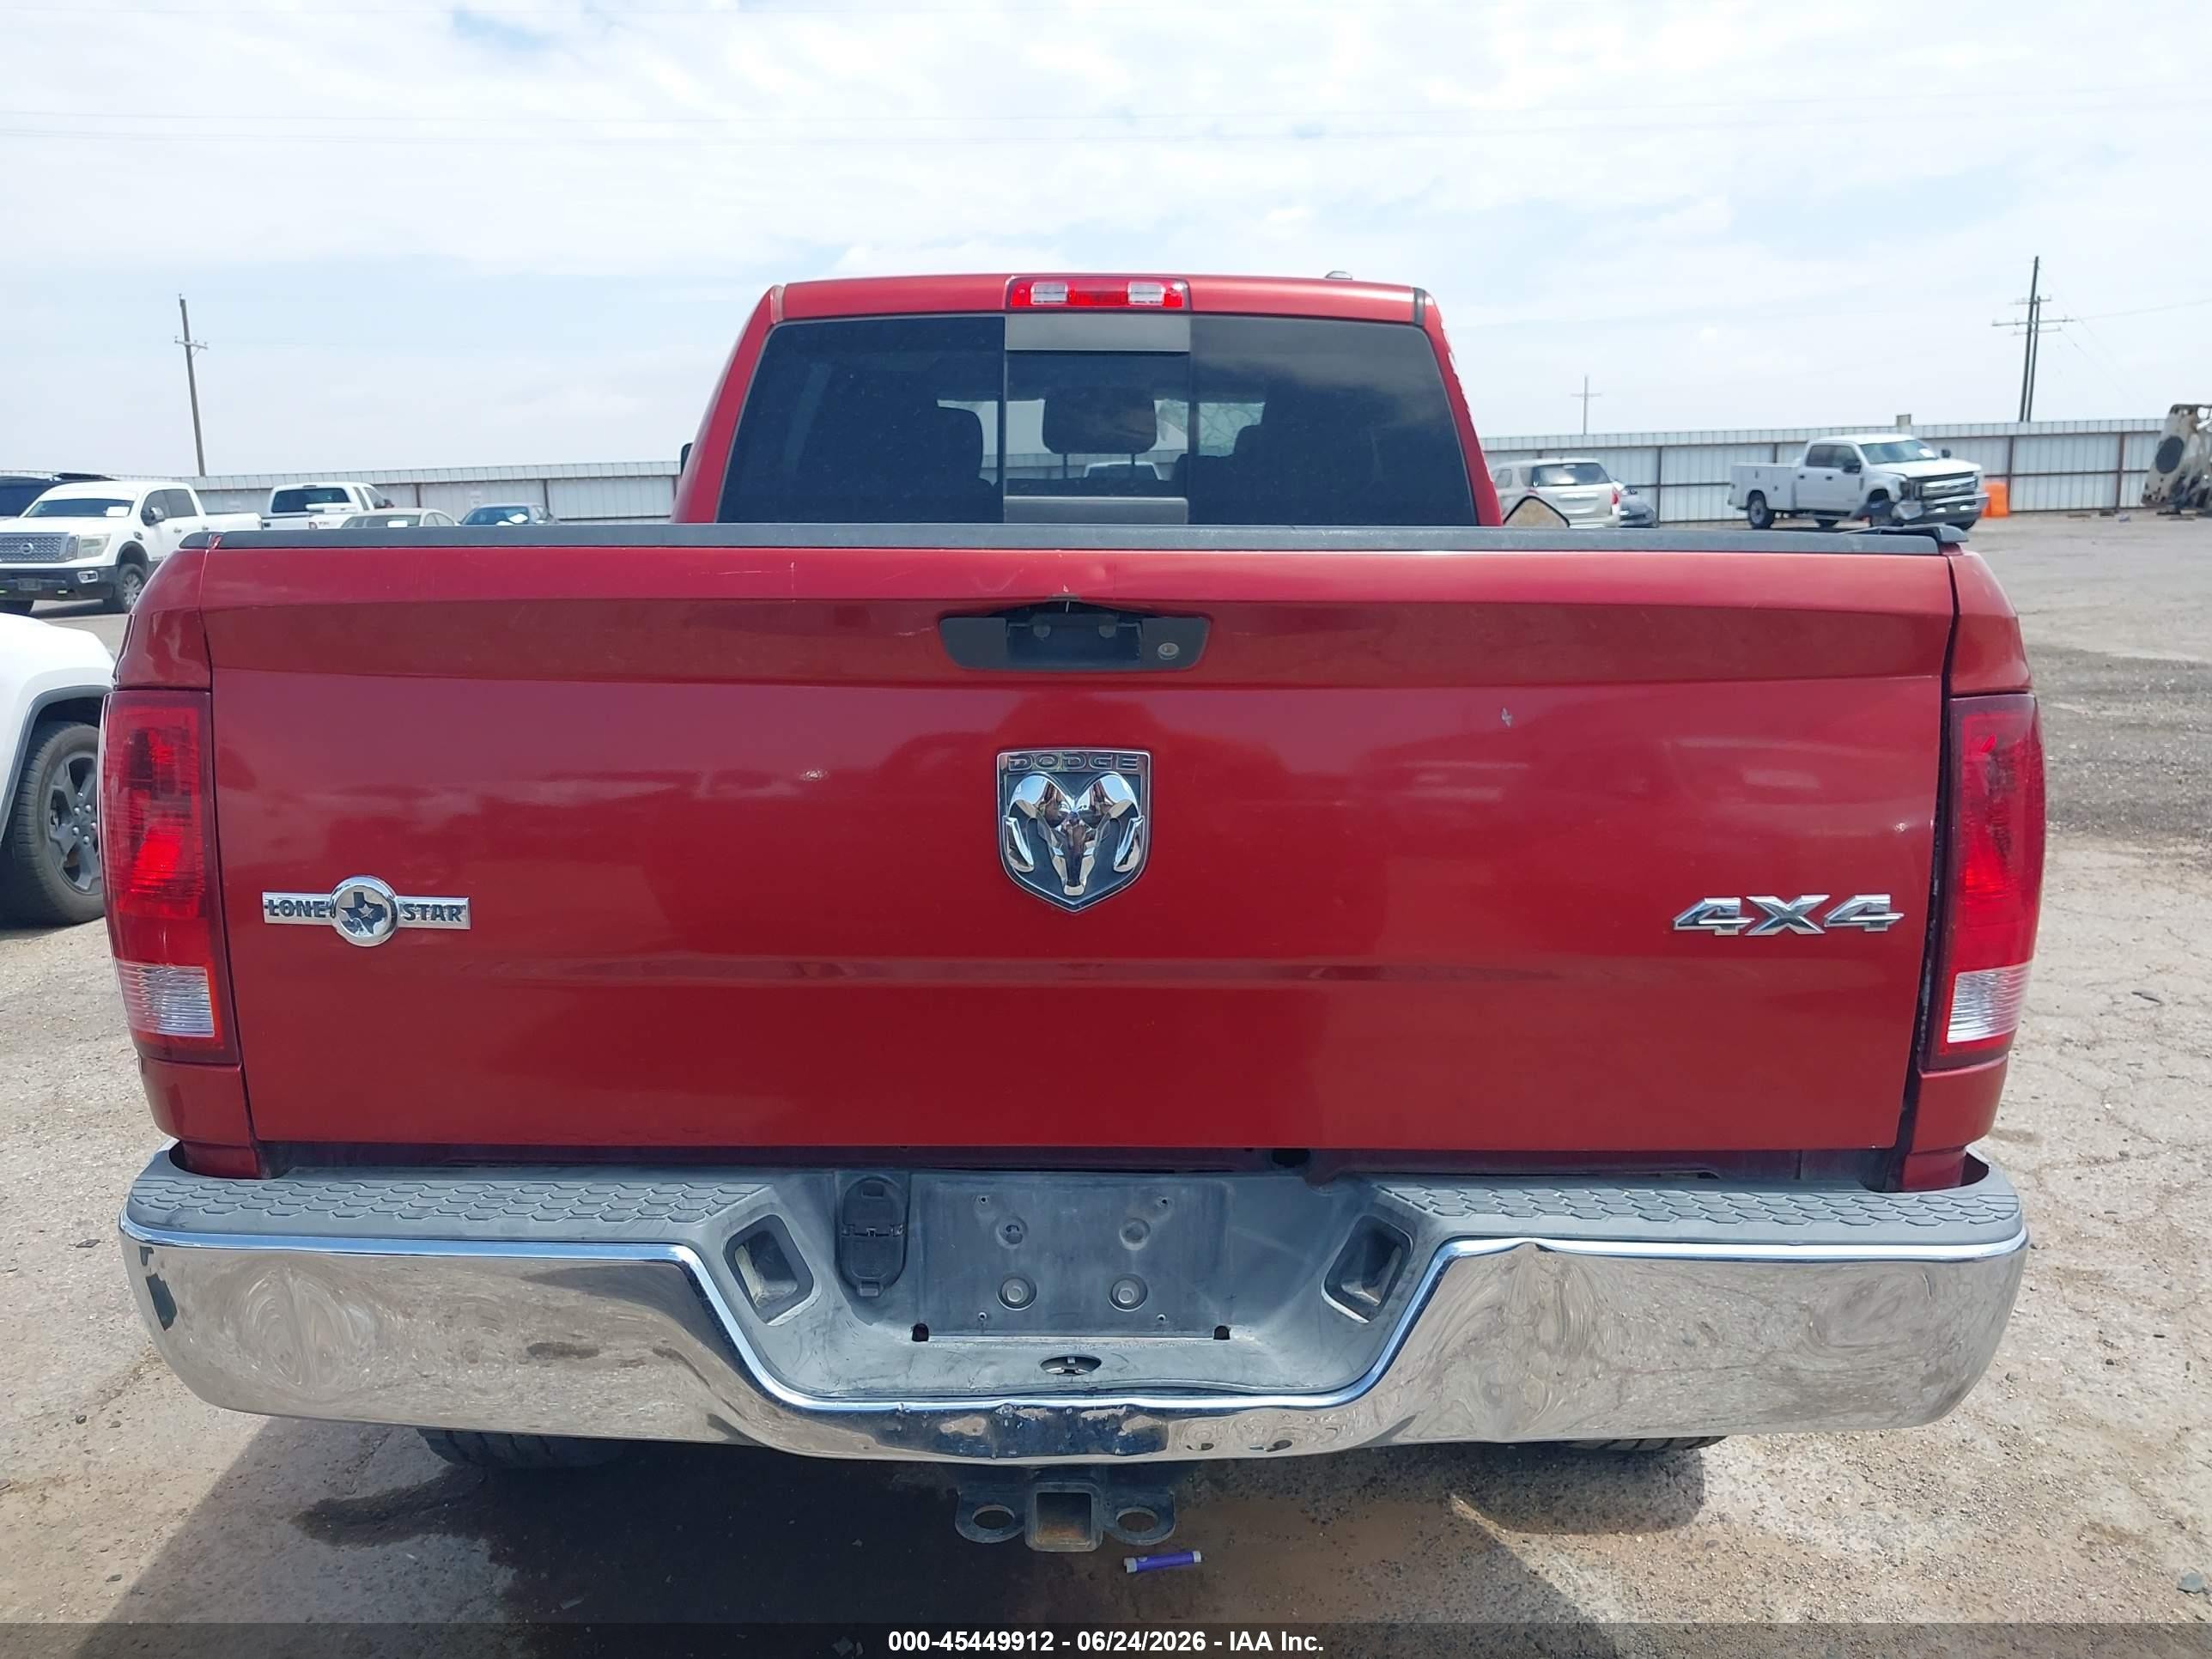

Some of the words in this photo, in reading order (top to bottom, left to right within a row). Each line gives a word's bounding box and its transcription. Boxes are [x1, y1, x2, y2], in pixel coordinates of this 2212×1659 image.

[1008, 754, 1139, 771] DODGE
[264, 899, 328, 918] LONE
[402, 903, 464, 922] STAR
[1673, 894, 1905, 936] 4X4
